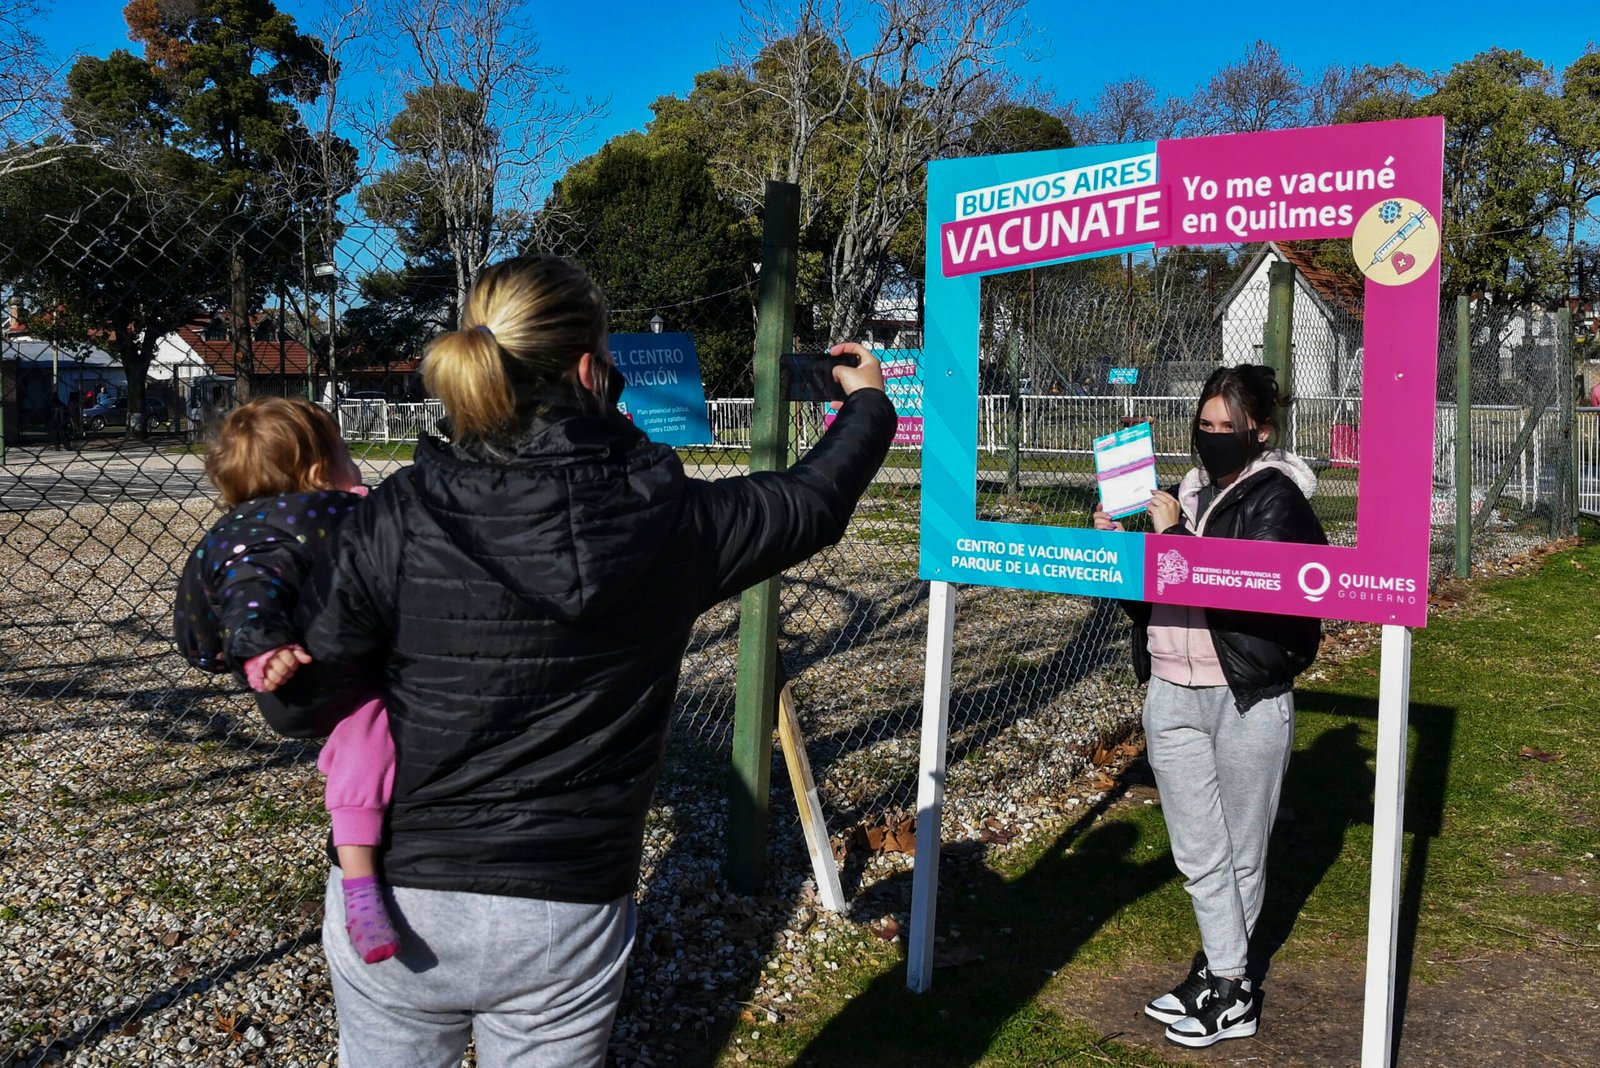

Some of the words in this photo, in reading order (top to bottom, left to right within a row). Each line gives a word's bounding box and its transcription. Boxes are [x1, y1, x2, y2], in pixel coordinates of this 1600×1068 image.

[962, 176, 1066, 217] BUENOS
[1073, 159, 1152, 195] AIRES
[1182, 175, 1219, 201] Yo
[1226, 175, 1272, 198] me
[1280, 155, 1396, 195] vacuné
[946, 191, 1162, 265] VACUNATE
[1182, 212, 1217, 234] en
[1225, 201, 1353, 237] Quilmes
[629, 348, 684, 365] CENTRO
[623, 366, 678, 387] NACIÓN
[882, 366, 915, 376] ACUNATE
[956, 538, 1006, 555] CENTRO
[1009, 543, 1025, 557] DE
[1028, 545, 1118, 564] VACUNACIÓN
[951, 556, 1002, 572] PARQUE
[1005, 561, 1021, 574] DE
[1025, 562, 1040, 576] LA
[1043, 564, 1123, 584] CERVECERÍA
[1192, 566, 1222, 574] GOBIERNO
[1240, 570, 1271, 578] PROVINCIA
[1192, 573, 1242, 587] BUENOS
[1244, 578, 1281, 591] AIRES
[1338, 573, 1416, 592] QUILMES
[1338, 590, 1416, 605] GOBIERNO
